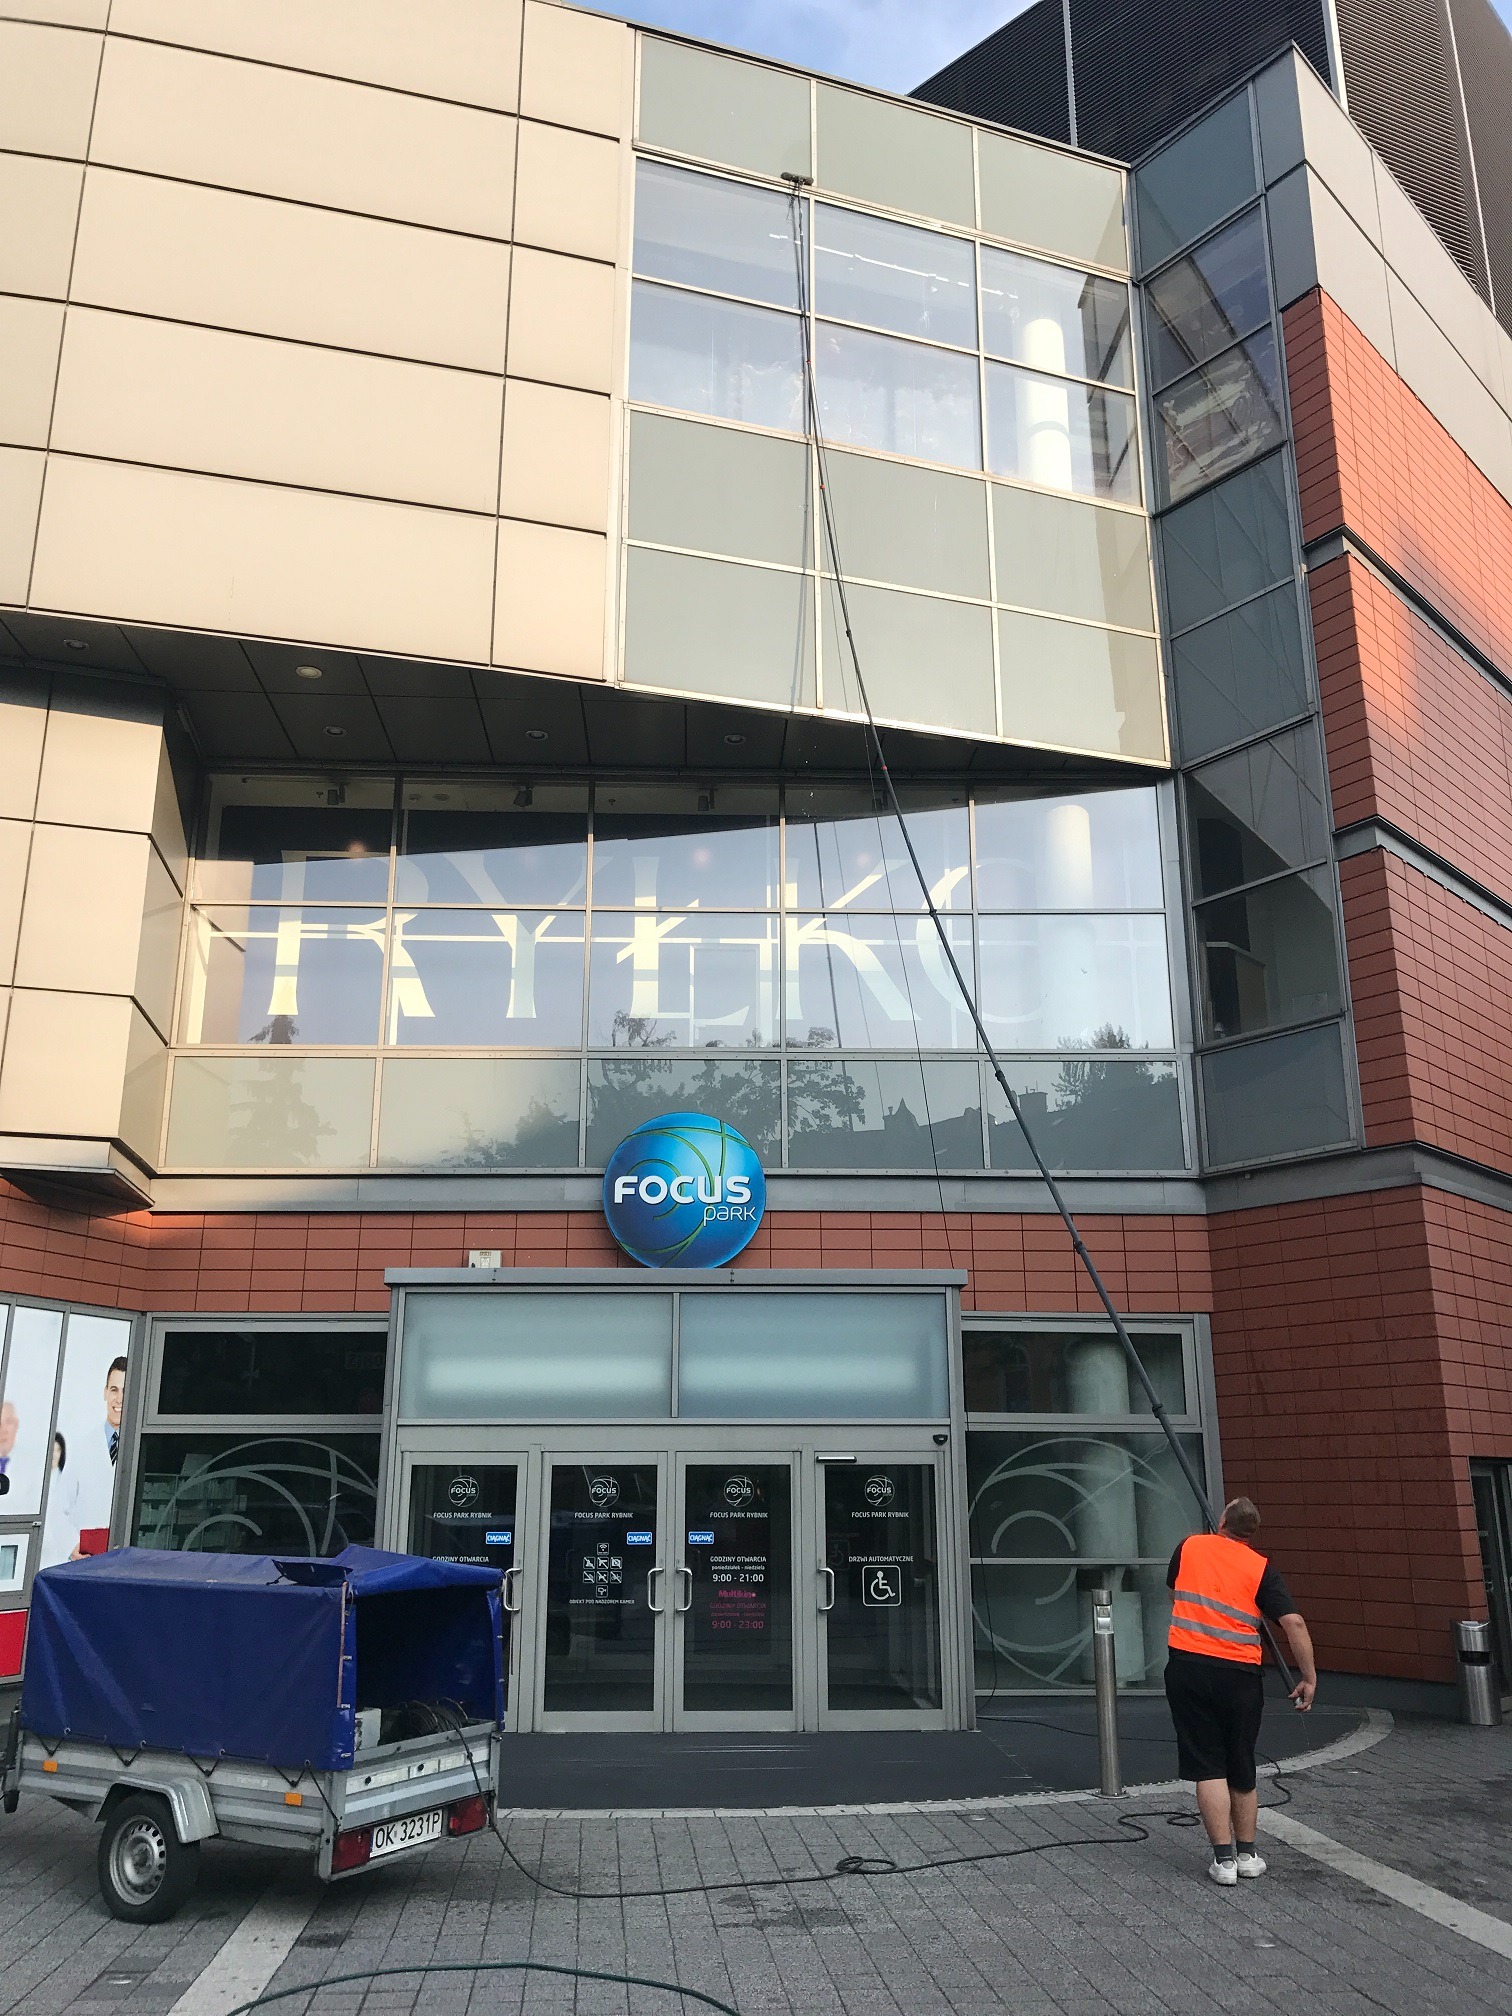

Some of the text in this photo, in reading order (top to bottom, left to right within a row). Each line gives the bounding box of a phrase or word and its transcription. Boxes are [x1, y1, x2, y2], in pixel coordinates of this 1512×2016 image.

[614, 1175, 752, 1205] FOCUS
[712, 1573, 732, 1582] 9:00
[739, 1573, 764, 1582] 21:00
[711, 1620, 732, 1629] 9:00
[739, 1620, 764, 1629] 23:00
[375, 1812, 440, 1849] OK 3231P
